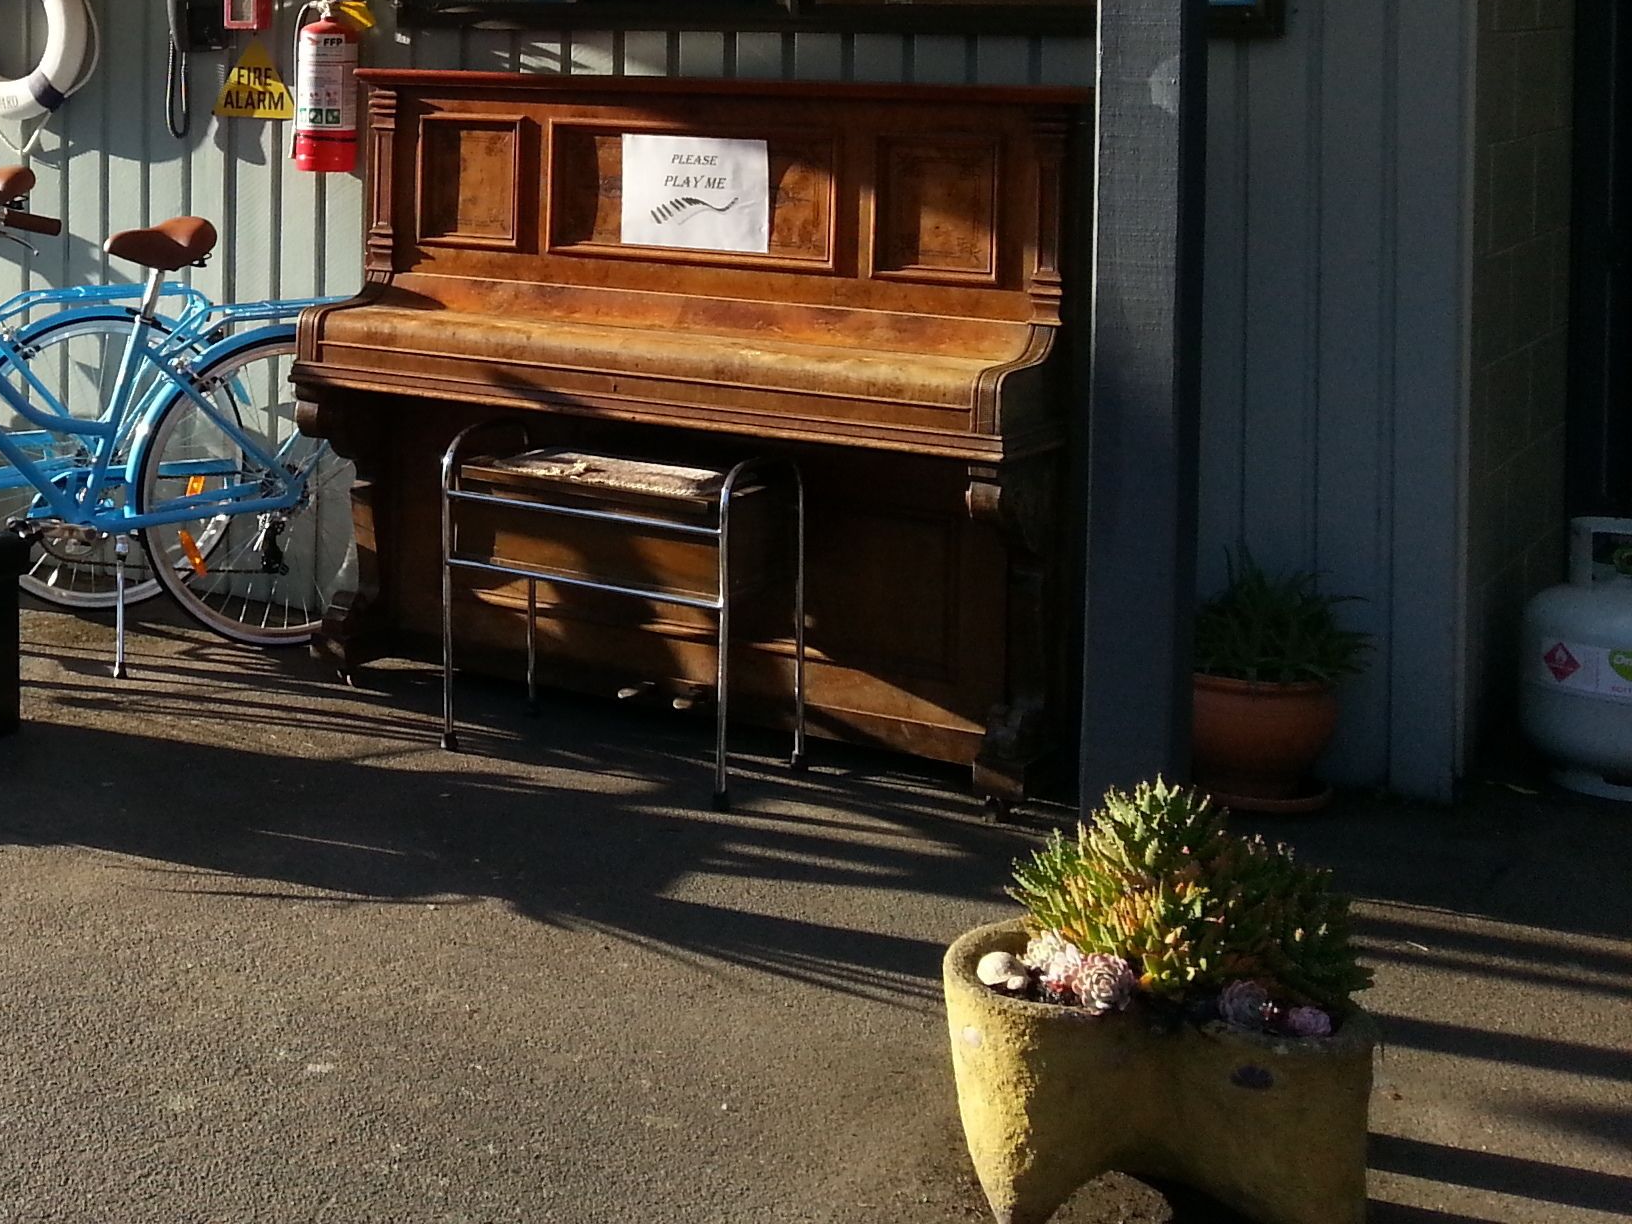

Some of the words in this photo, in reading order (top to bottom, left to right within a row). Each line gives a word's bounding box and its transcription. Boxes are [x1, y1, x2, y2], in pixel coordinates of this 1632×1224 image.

[323, 38, 343, 47] FFP
[237, 66, 273, 87] FIRE
[224, 90, 284, 111] ALARM
[671, 154, 718, 166] PLEASE
[664, 175, 705, 188] PLAY
[704, 177, 727, 190] ME
